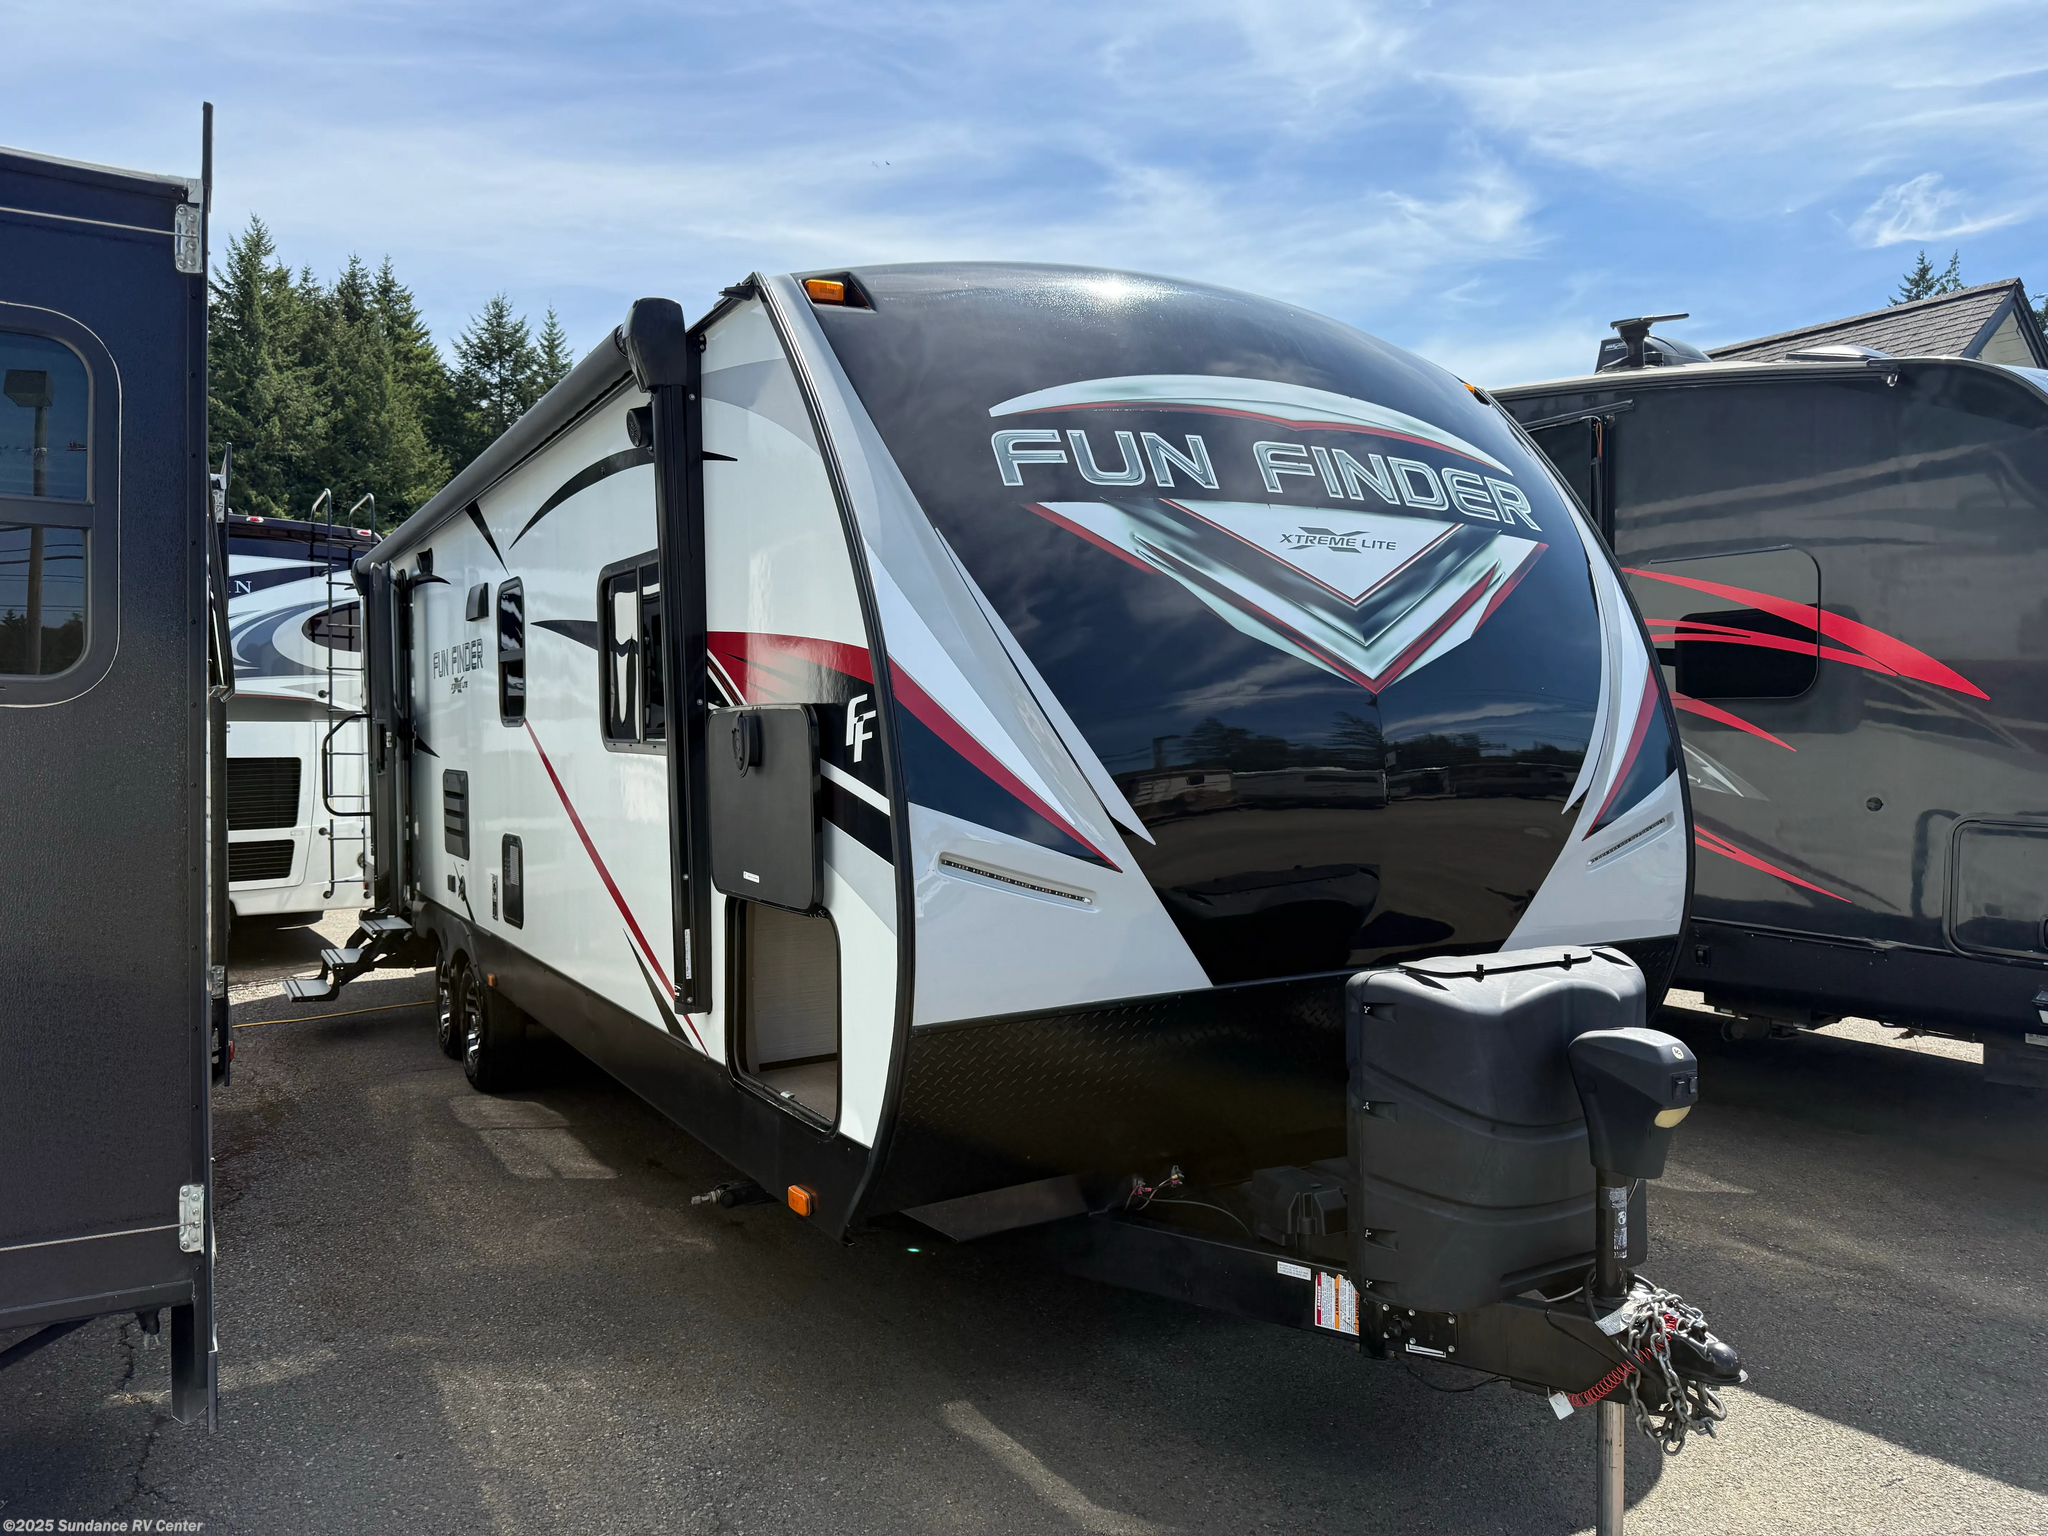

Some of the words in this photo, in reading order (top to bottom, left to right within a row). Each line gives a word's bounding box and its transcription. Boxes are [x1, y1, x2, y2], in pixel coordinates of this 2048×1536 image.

[990, 429, 1220, 490] FUN
[1252, 440, 1543, 532] FINDER
[1279, 533, 1357, 548] XTREME
[1361, 539, 1397, 551] LITE
[228, 580, 252, 594] N
[433, 648, 450, 680] FUN
[451, 638, 484, 675] FINDER
